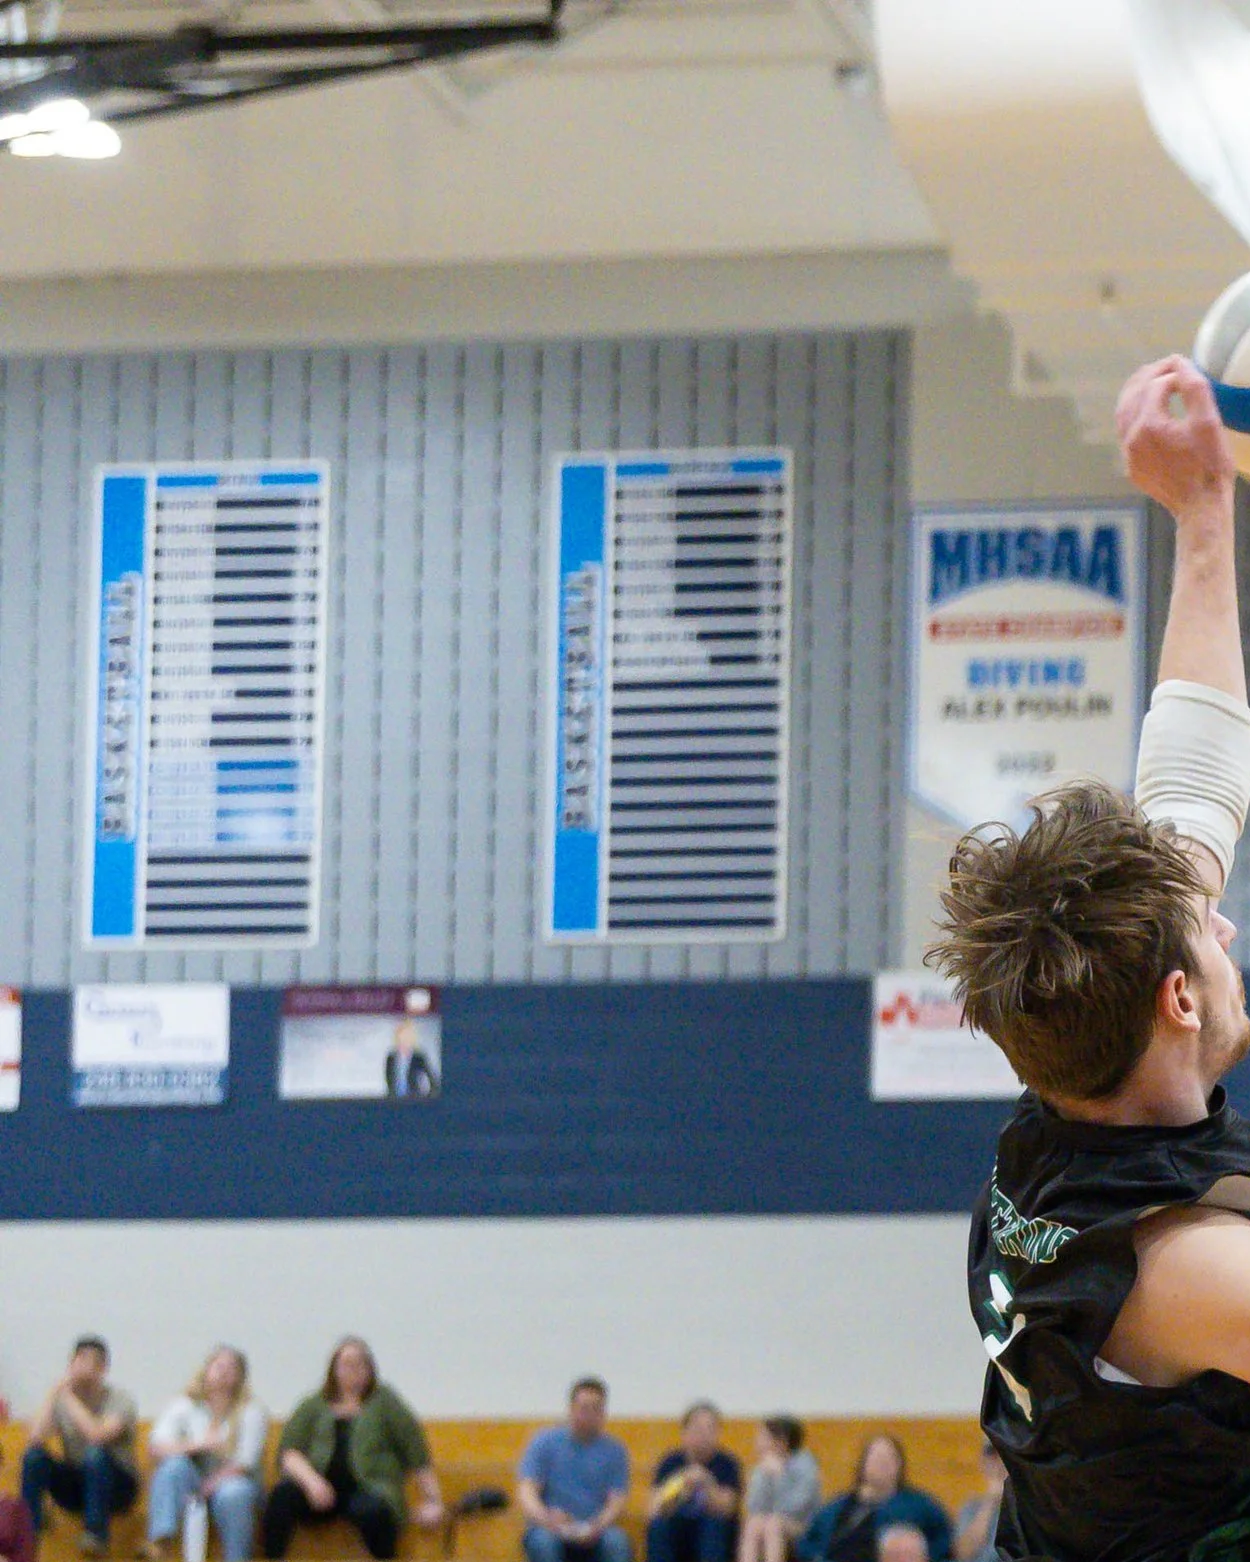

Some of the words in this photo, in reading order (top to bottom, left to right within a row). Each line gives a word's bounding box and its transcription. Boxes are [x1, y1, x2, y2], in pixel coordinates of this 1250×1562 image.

[930, 525, 1124, 604] MHSAA
[563, 568, 598, 831] BASKETBALL
[968, 657, 1086, 690] DIVING
[942, 697, 1004, 720] ALEX
